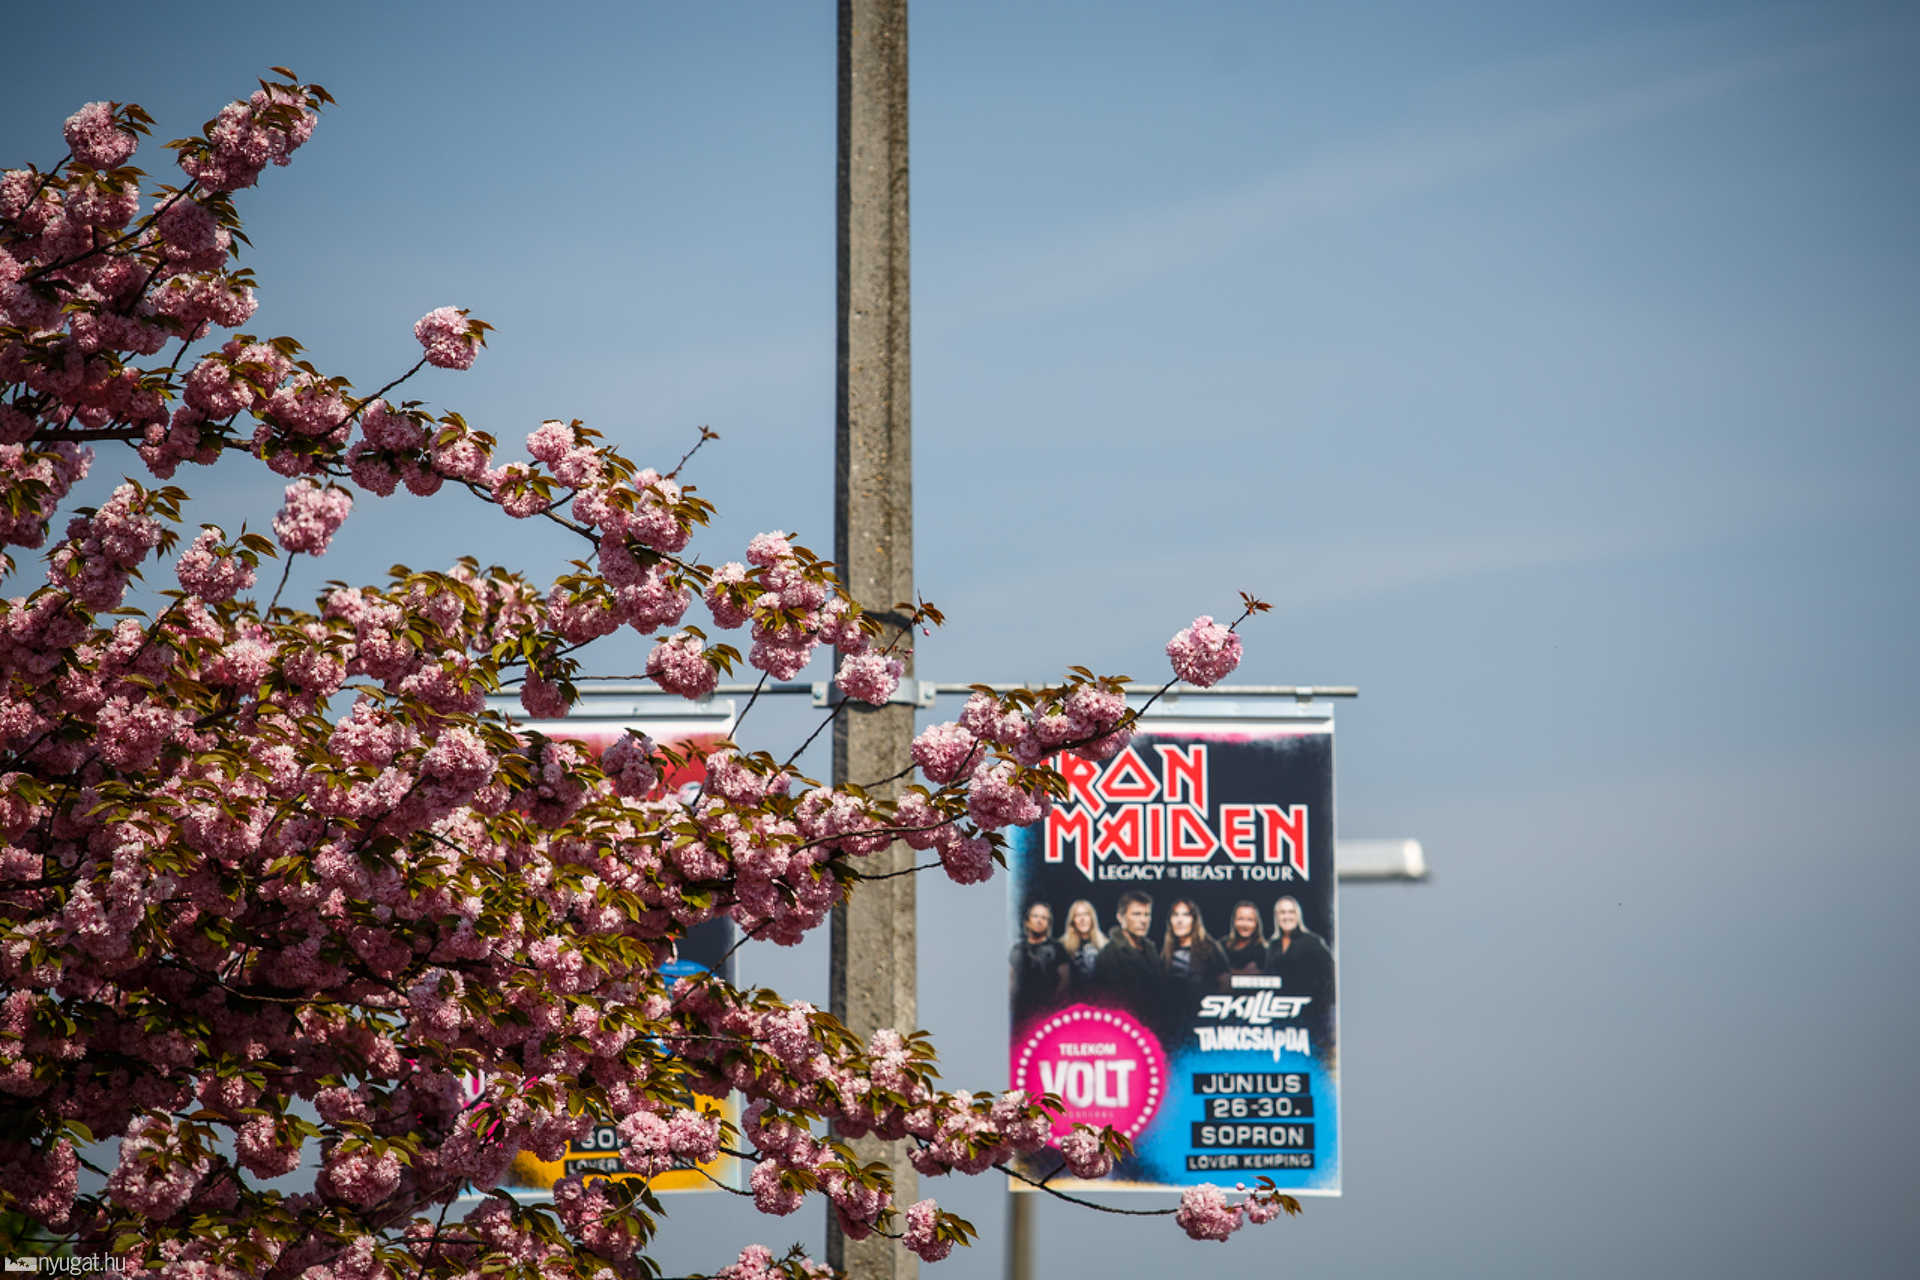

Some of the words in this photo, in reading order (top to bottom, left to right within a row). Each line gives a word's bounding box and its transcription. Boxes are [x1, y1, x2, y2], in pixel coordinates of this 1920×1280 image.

[1044, 803, 1310, 882] MAIDEN
[1098, 865, 1165, 881] LEGACY
[1181, 865, 1235, 881] BEAST
[1240, 865, 1294, 881] TOUR
[1198, 990, 1312, 1024] SKILLET
[1058, 1043, 1117, 1057] TELEKOM
[1038, 1059, 1137, 1109] VOLT
[1213, 1098, 1302, 1118] 26-30.
[1201, 1126, 1304, 1146] SOPRON
[1243, 1153, 1312, 1168] KEMPING
